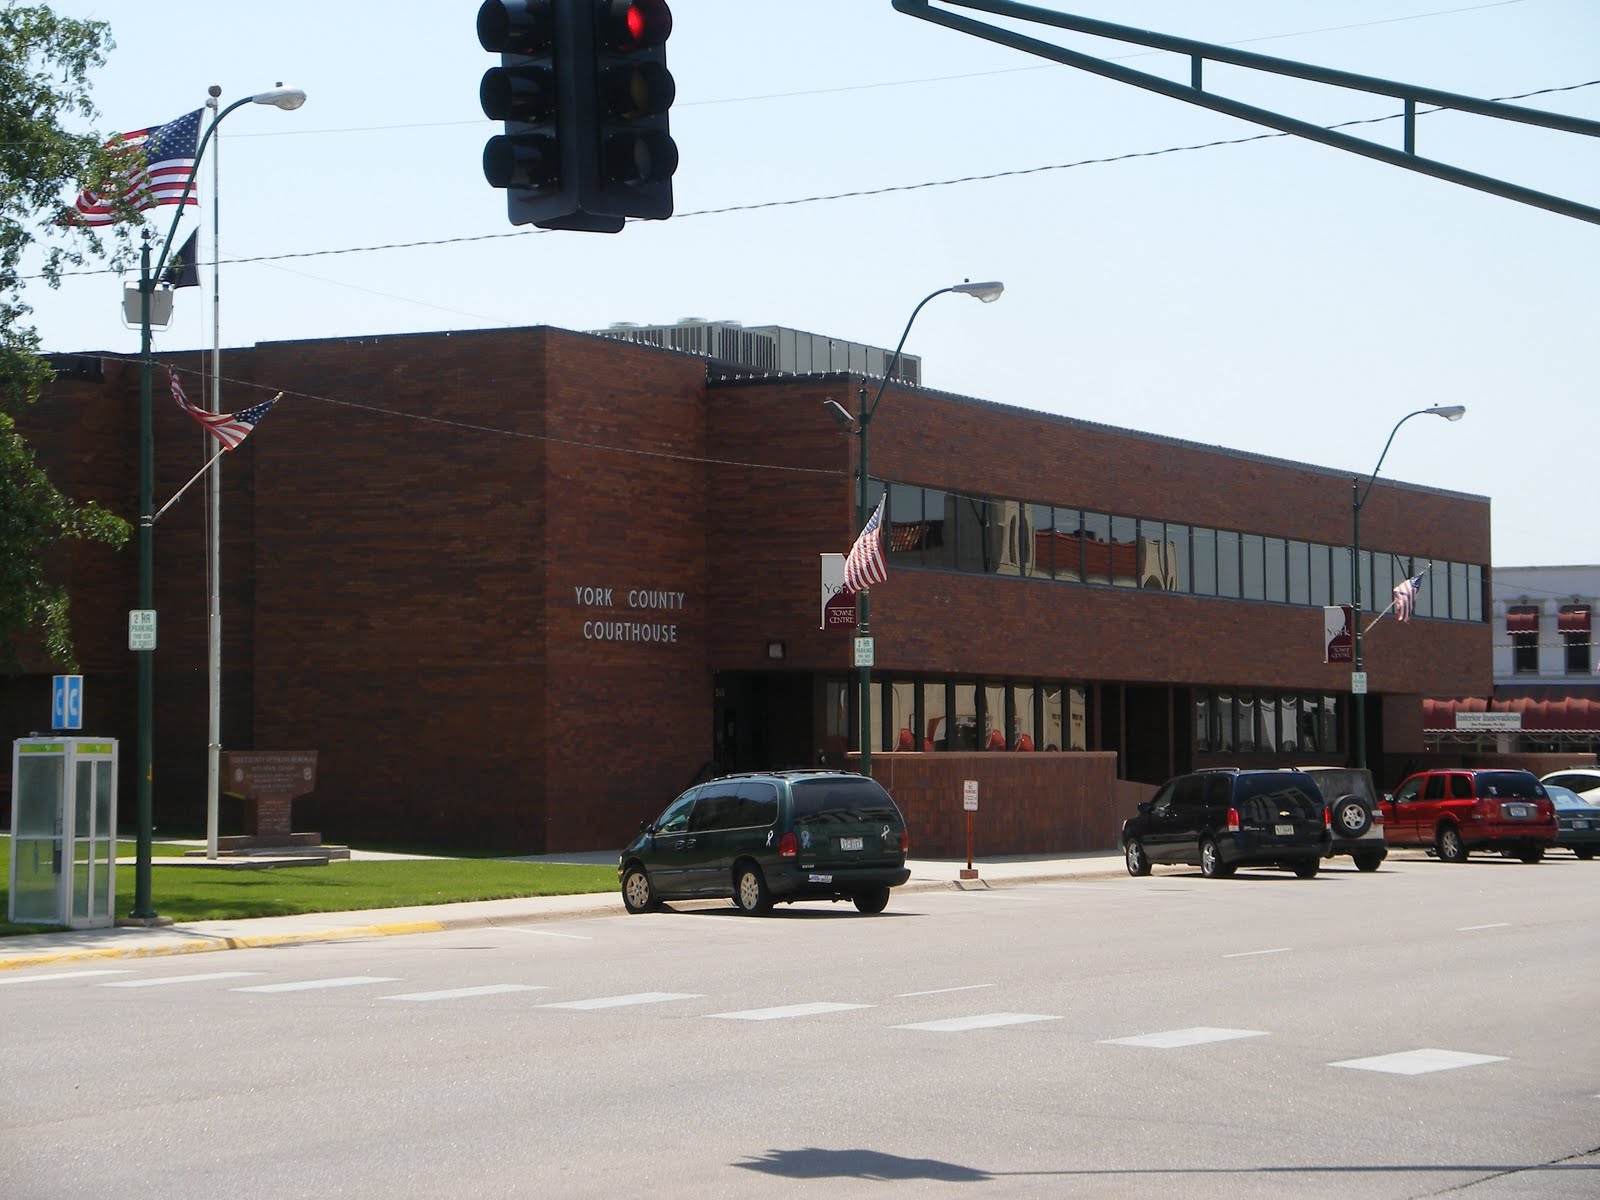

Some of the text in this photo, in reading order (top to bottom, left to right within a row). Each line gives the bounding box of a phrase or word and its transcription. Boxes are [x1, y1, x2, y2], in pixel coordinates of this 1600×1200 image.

[575, 586, 685, 609] YORK COUNTY
[133, 614, 138, 624] 2
[583, 621, 677, 643] COURTHOUSE
[1327, 625, 1351, 636] York
